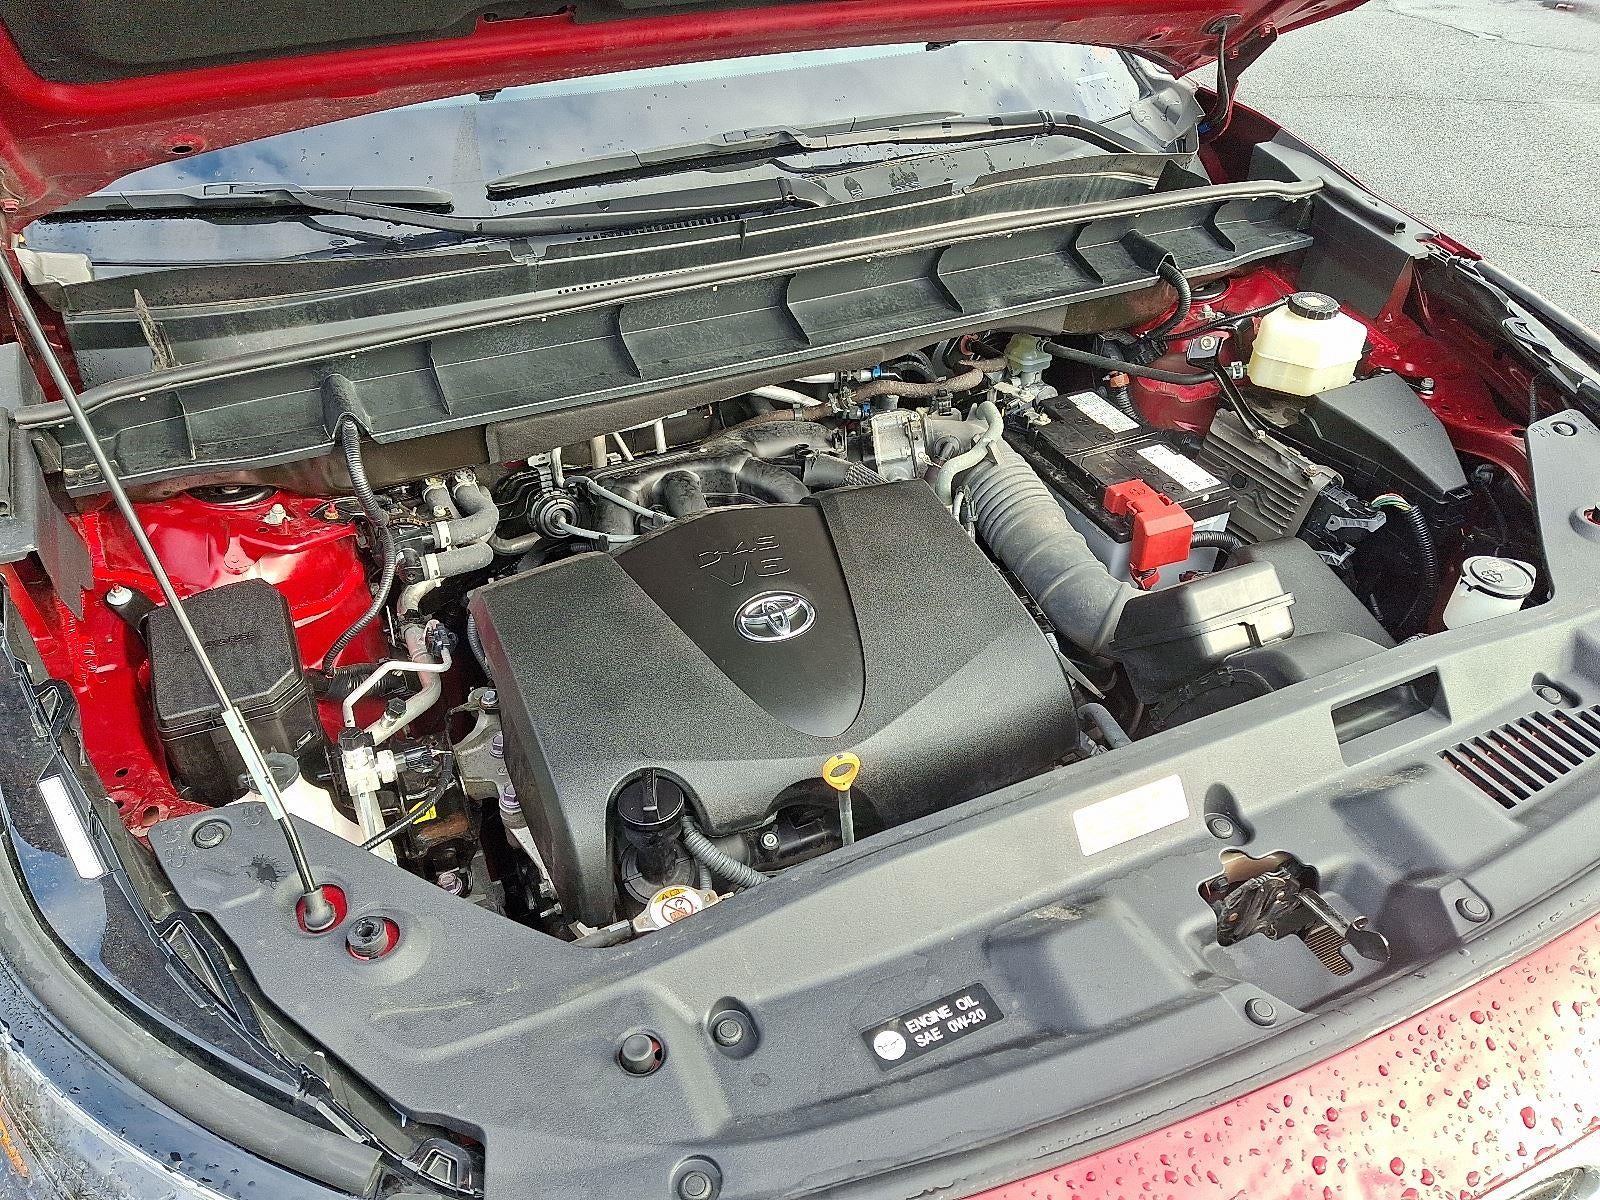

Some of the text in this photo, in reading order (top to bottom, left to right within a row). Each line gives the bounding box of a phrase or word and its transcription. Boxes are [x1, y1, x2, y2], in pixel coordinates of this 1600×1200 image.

[905, 995, 979, 1033] ENGINE OIL
[914, 1008, 987, 1047] SAE 0W-20
